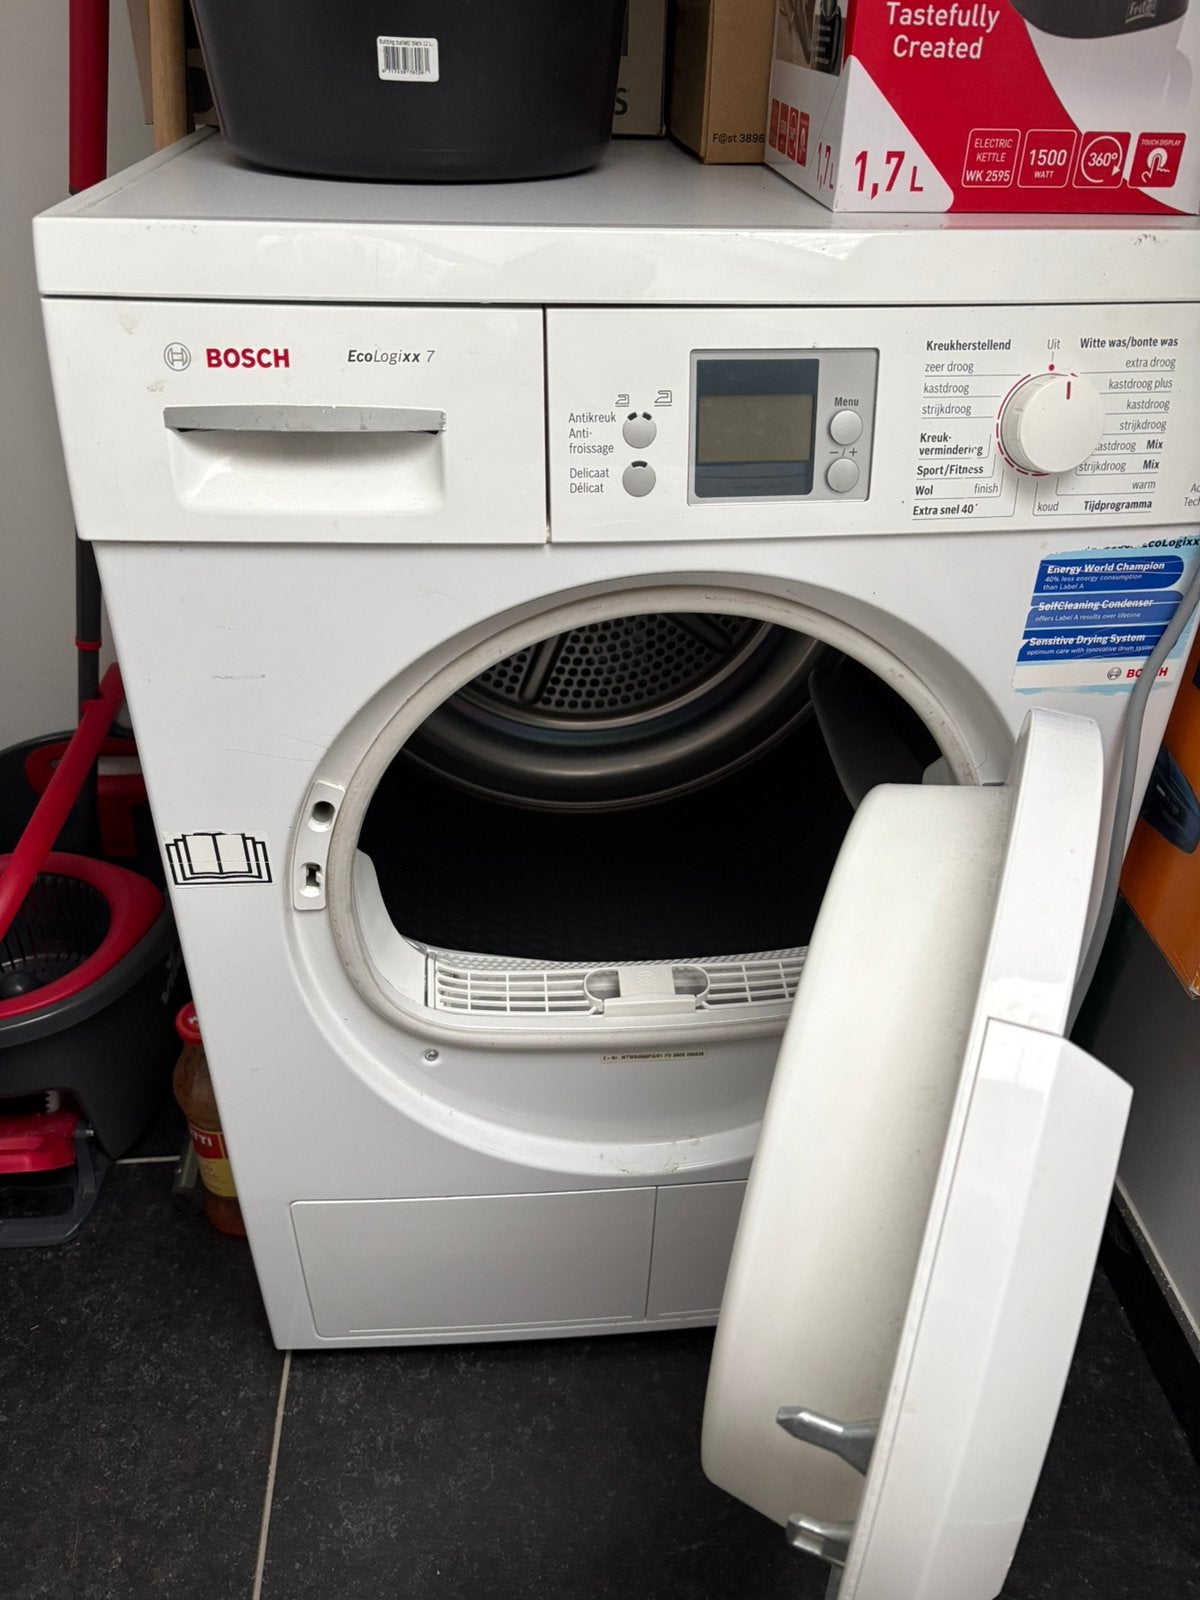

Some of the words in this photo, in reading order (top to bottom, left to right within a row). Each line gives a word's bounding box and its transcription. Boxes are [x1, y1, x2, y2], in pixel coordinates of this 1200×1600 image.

[886, 1, 1000, 33] Tastefully
[893, 34, 984, 59] Created
[713, 133, 737, 144] F@st
[739, 133, 765, 143] 3896
[974, 138, 1013, 148] ELECTRIC
[1141, 138, 1159, 146] TOUCH
[1159, 138, 1182, 147] DISPLAY
[976, 152, 1006, 162] KETTLE
[1029, 149, 1067, 166] 1500
[966, 170, 983, 181] WK
[985, 170, 1010, 182] 2595
[1034, 171, 1054, 179] WATT
[926, 339, 1011, 351] Kreukherstellend
[1047, 338, 1061, 350] Uit
[1080, 337, 1106, 349] Witte
[1108, 336, 1158, 349] was/bonte
[1160, 337, 1179, 347] was
[206, 348, 290, 368] BOSCH
[347, 349, 421, 365] EcoLogixx
[426, 350, 436, 363] 7
[1125, 358, 1149, 369] extra
[1149, 356, 1176, 370] droog
[925, 363, 945, 372] zeer
[947, 361, 974, 374] droog
[923, 382, 970, 395] kastdroog
[1108, 378, 1153, 391] kastdroog
[1153, 378, 1173, 391] plus
[834, 396, 859, 406] Menu
[1126, 399, 1170, 411] kastdroog
[921, 403, 972, 416] strijkdroog
[568, 411, 616, 423] Antikreuk
[1119, 419, 1167, 432] strijkdroog
[568, 428, 592, 438] Anti-
[920, 432, 952, 443] Kreuk-
[569, 442, 614, 455] froissage
[1094, 439, 1136, 453] astdroog
[1146, 439, 1163, 450] Mix
[917, 464, 984, 477] Sport/Fitness
[1078, 460, 1126, 473] strijkdroog
[1142, 459, 1160, 470] Mix
[569, 467, 610, 479] Delicaat
[569, 482, 604, 493] Délicat
[915, 485, 934, 495] Wol
[974, 483, 999, 494] finish
[1132, 480, 1156, 490] warm
[913, 505, 938, 516] Extra
[939, 504, 960, 515] snel
[1037, 501, 1059, 512] koud
[1083, 499, 1152, 513] Tijdprogramma
[1047, 565, 1082, 575] Energy
[1084, 562, 1114, 572] World
[1116, 561, 1165, 574] Champion
[1076, 575, 1098, 583] energy
[1100, 573, 1143, 582] consumption
[1038, 600, 1099, 611] SelfCleaning
[1102, 598, 1154, 610] Condenser
[1117, 611, 1142, 619] lifetime
[1029, 636, 1074, 647] Sensitive
[1076, 634, 1108, 645] Drying
[1110, 633, 1146, 643] System
[1086, 645, 1117, 653] innovative
[1118, 643, 1134, 651] drum
[1126, 666, 1168, 679] BOH
